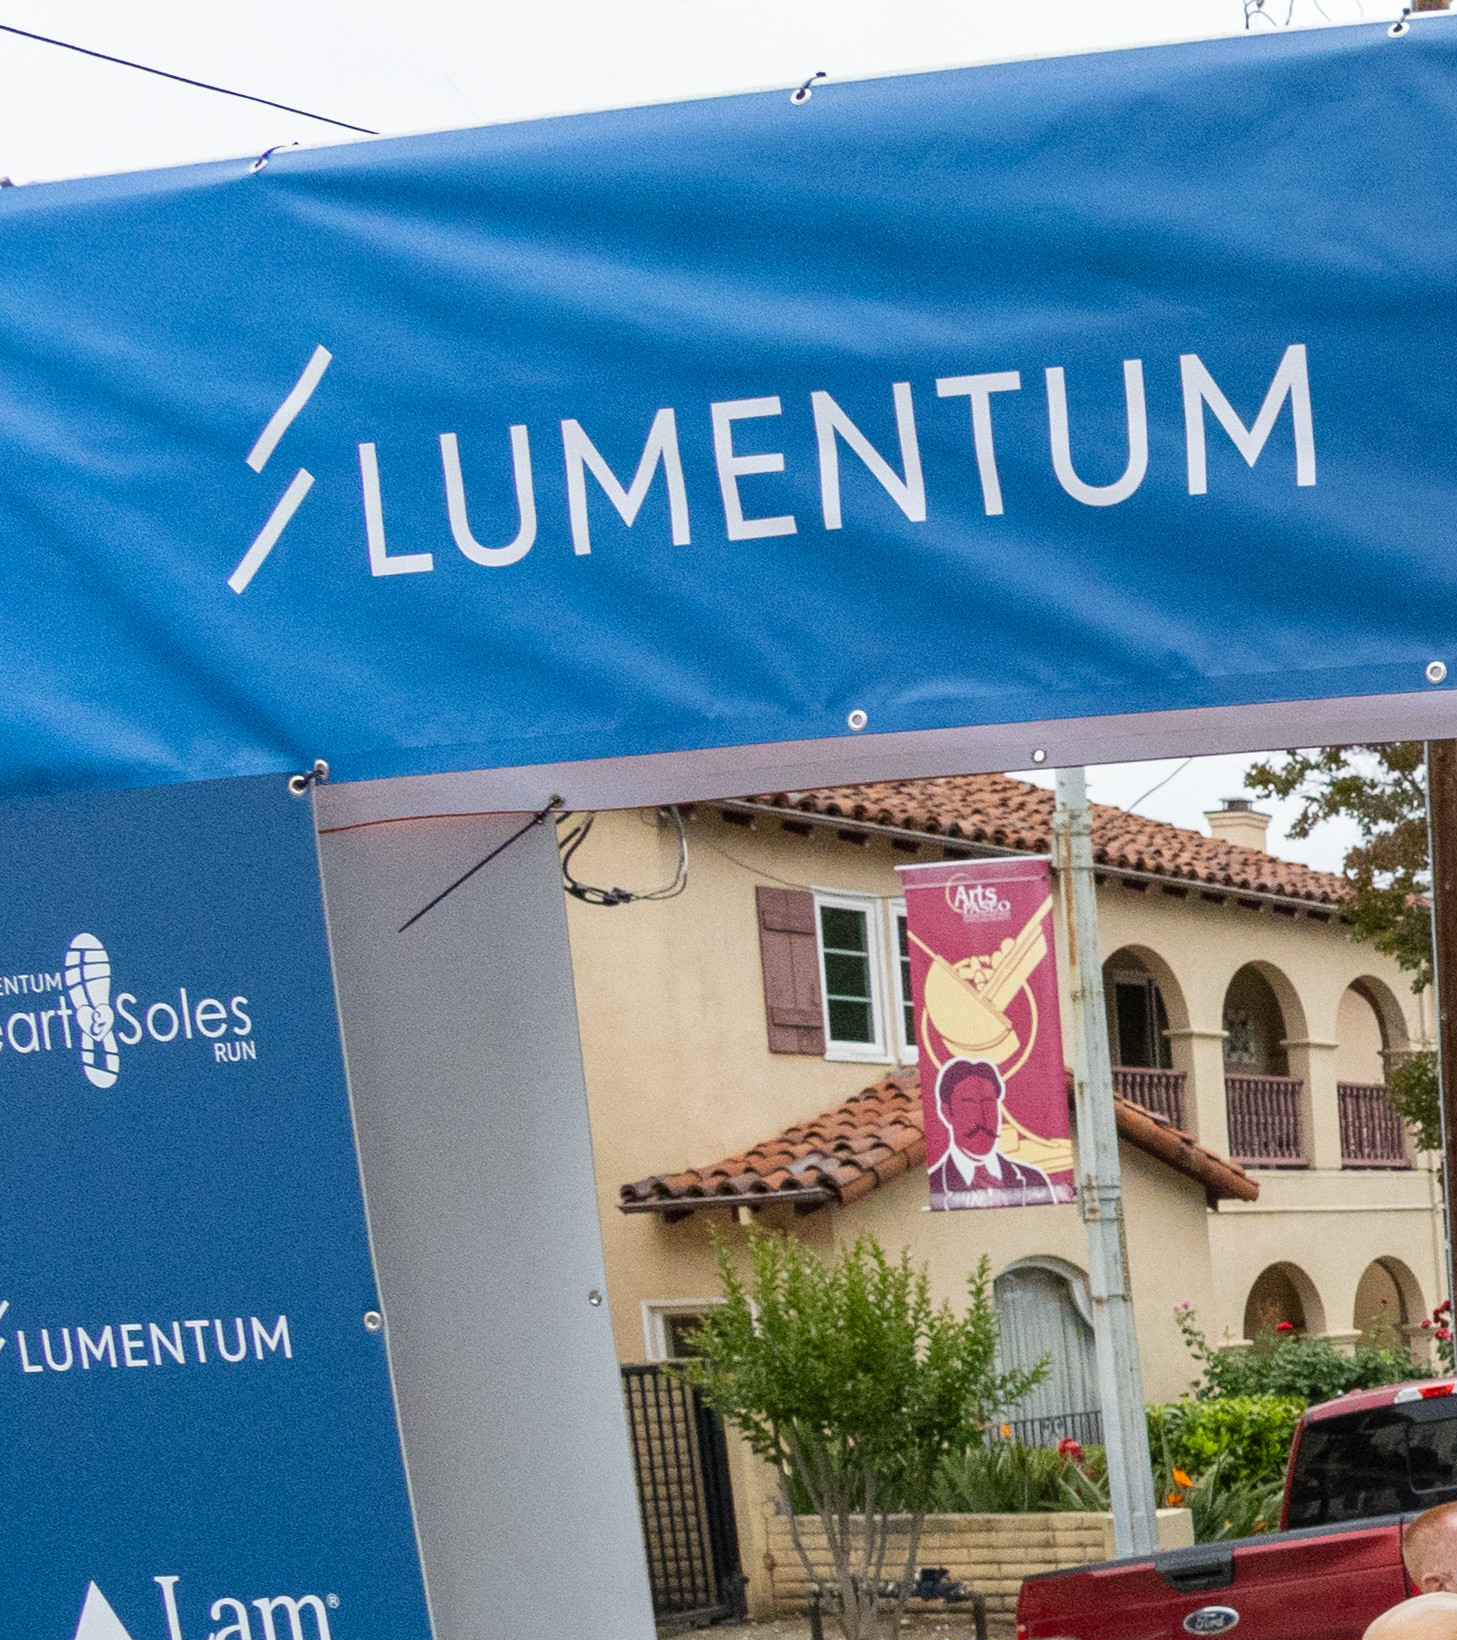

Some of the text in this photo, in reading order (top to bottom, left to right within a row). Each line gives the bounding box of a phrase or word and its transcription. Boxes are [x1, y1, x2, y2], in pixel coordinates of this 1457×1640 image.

[358, 343, 1317, 577] LUMENTUM
[954, 884, 998, 908] Arts
[0, 996, 72, 1053] art
[116, 988, 252, 1044] Soles
[213, 1040, 257, 1063] RUN
[16, 1314, 294, 1373] LUMENTUM
